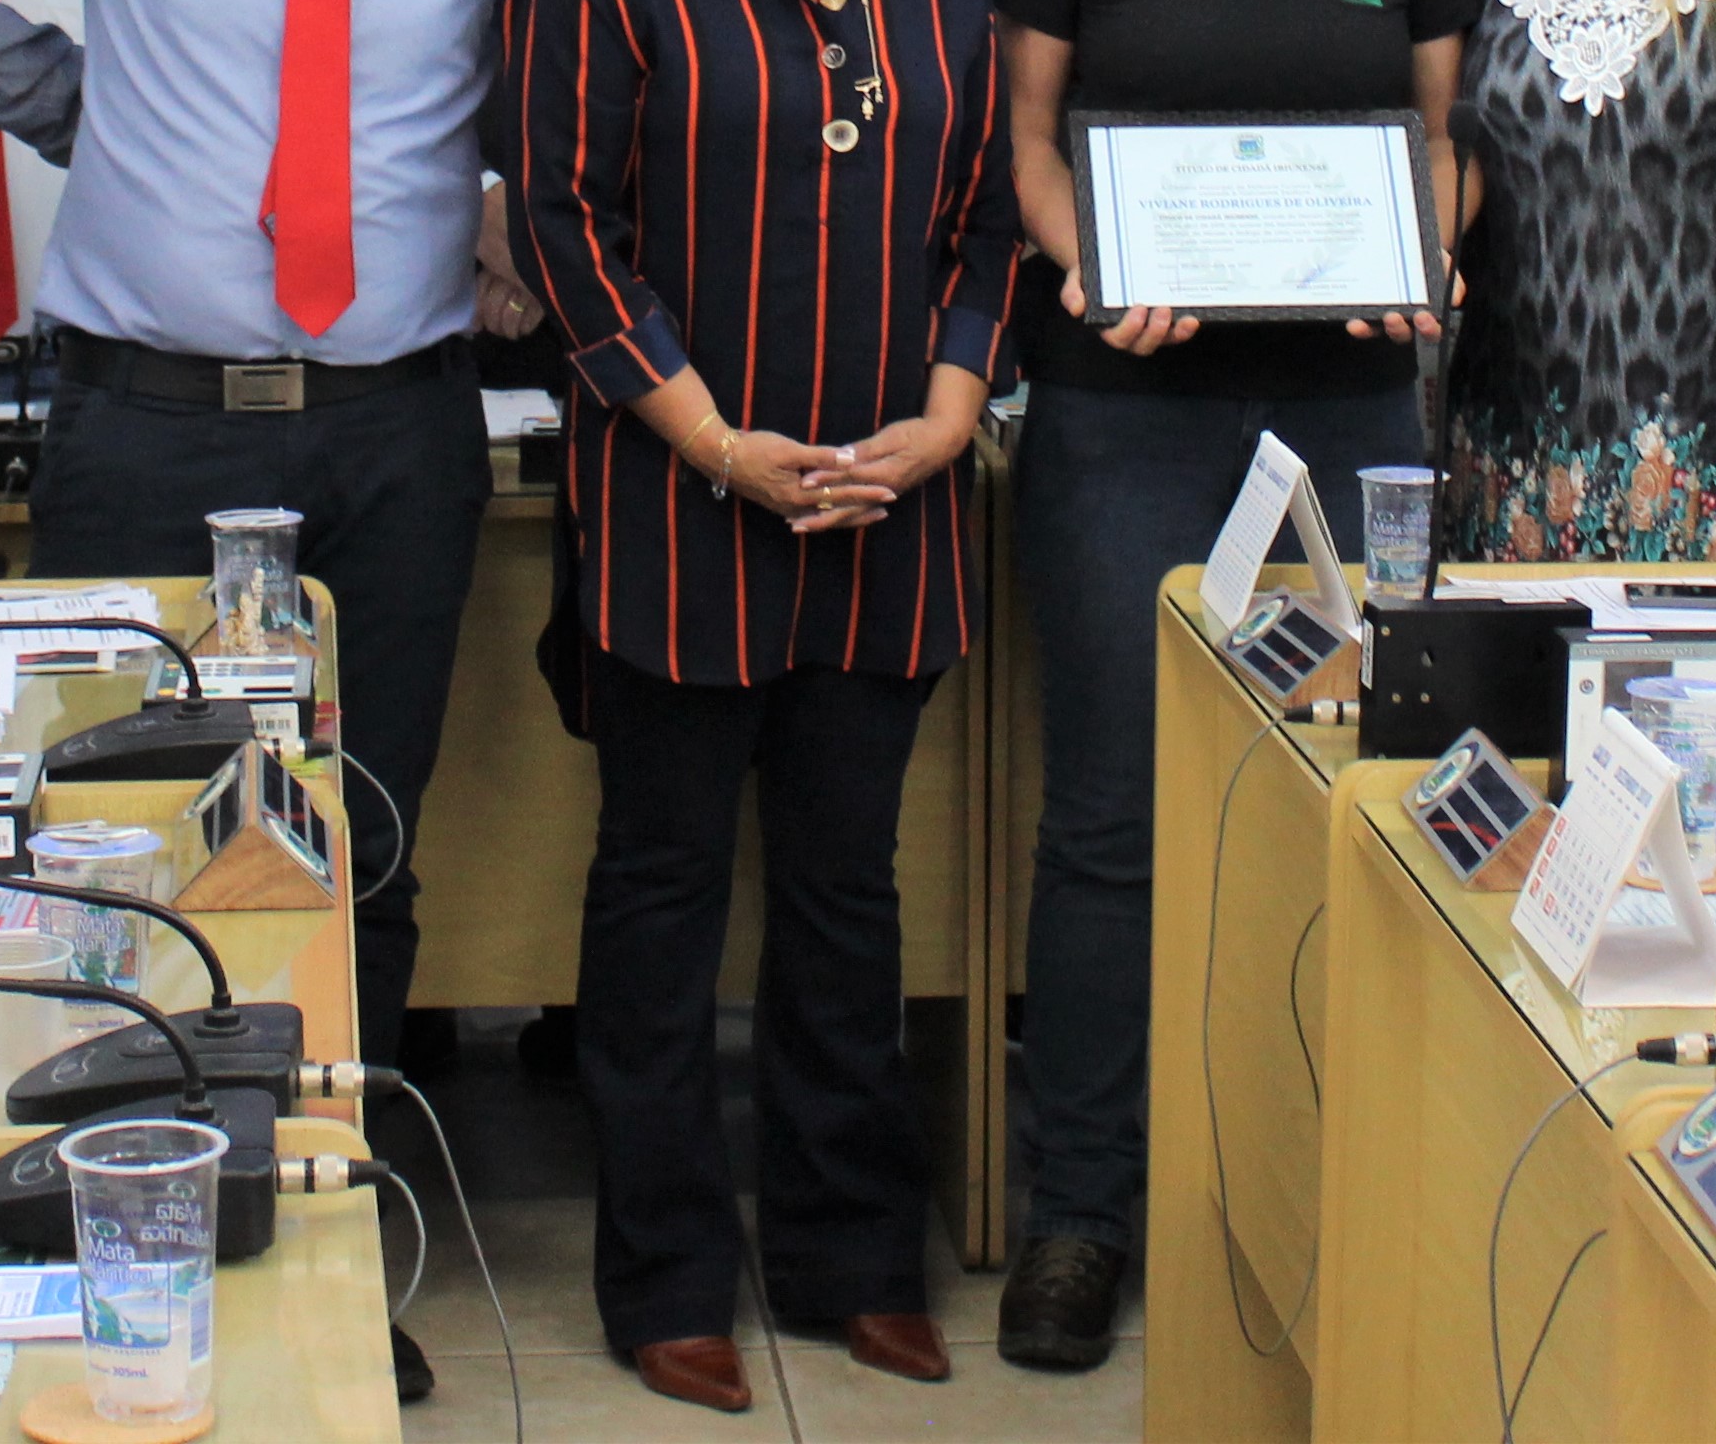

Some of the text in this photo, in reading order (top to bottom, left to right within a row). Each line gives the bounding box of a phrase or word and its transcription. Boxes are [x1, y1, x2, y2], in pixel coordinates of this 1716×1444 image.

[1138, 196, 1373, 209] VIVIANE RODRIGUES DE OLIVEIRA
[87, 1236, 136, 1261] Mata
